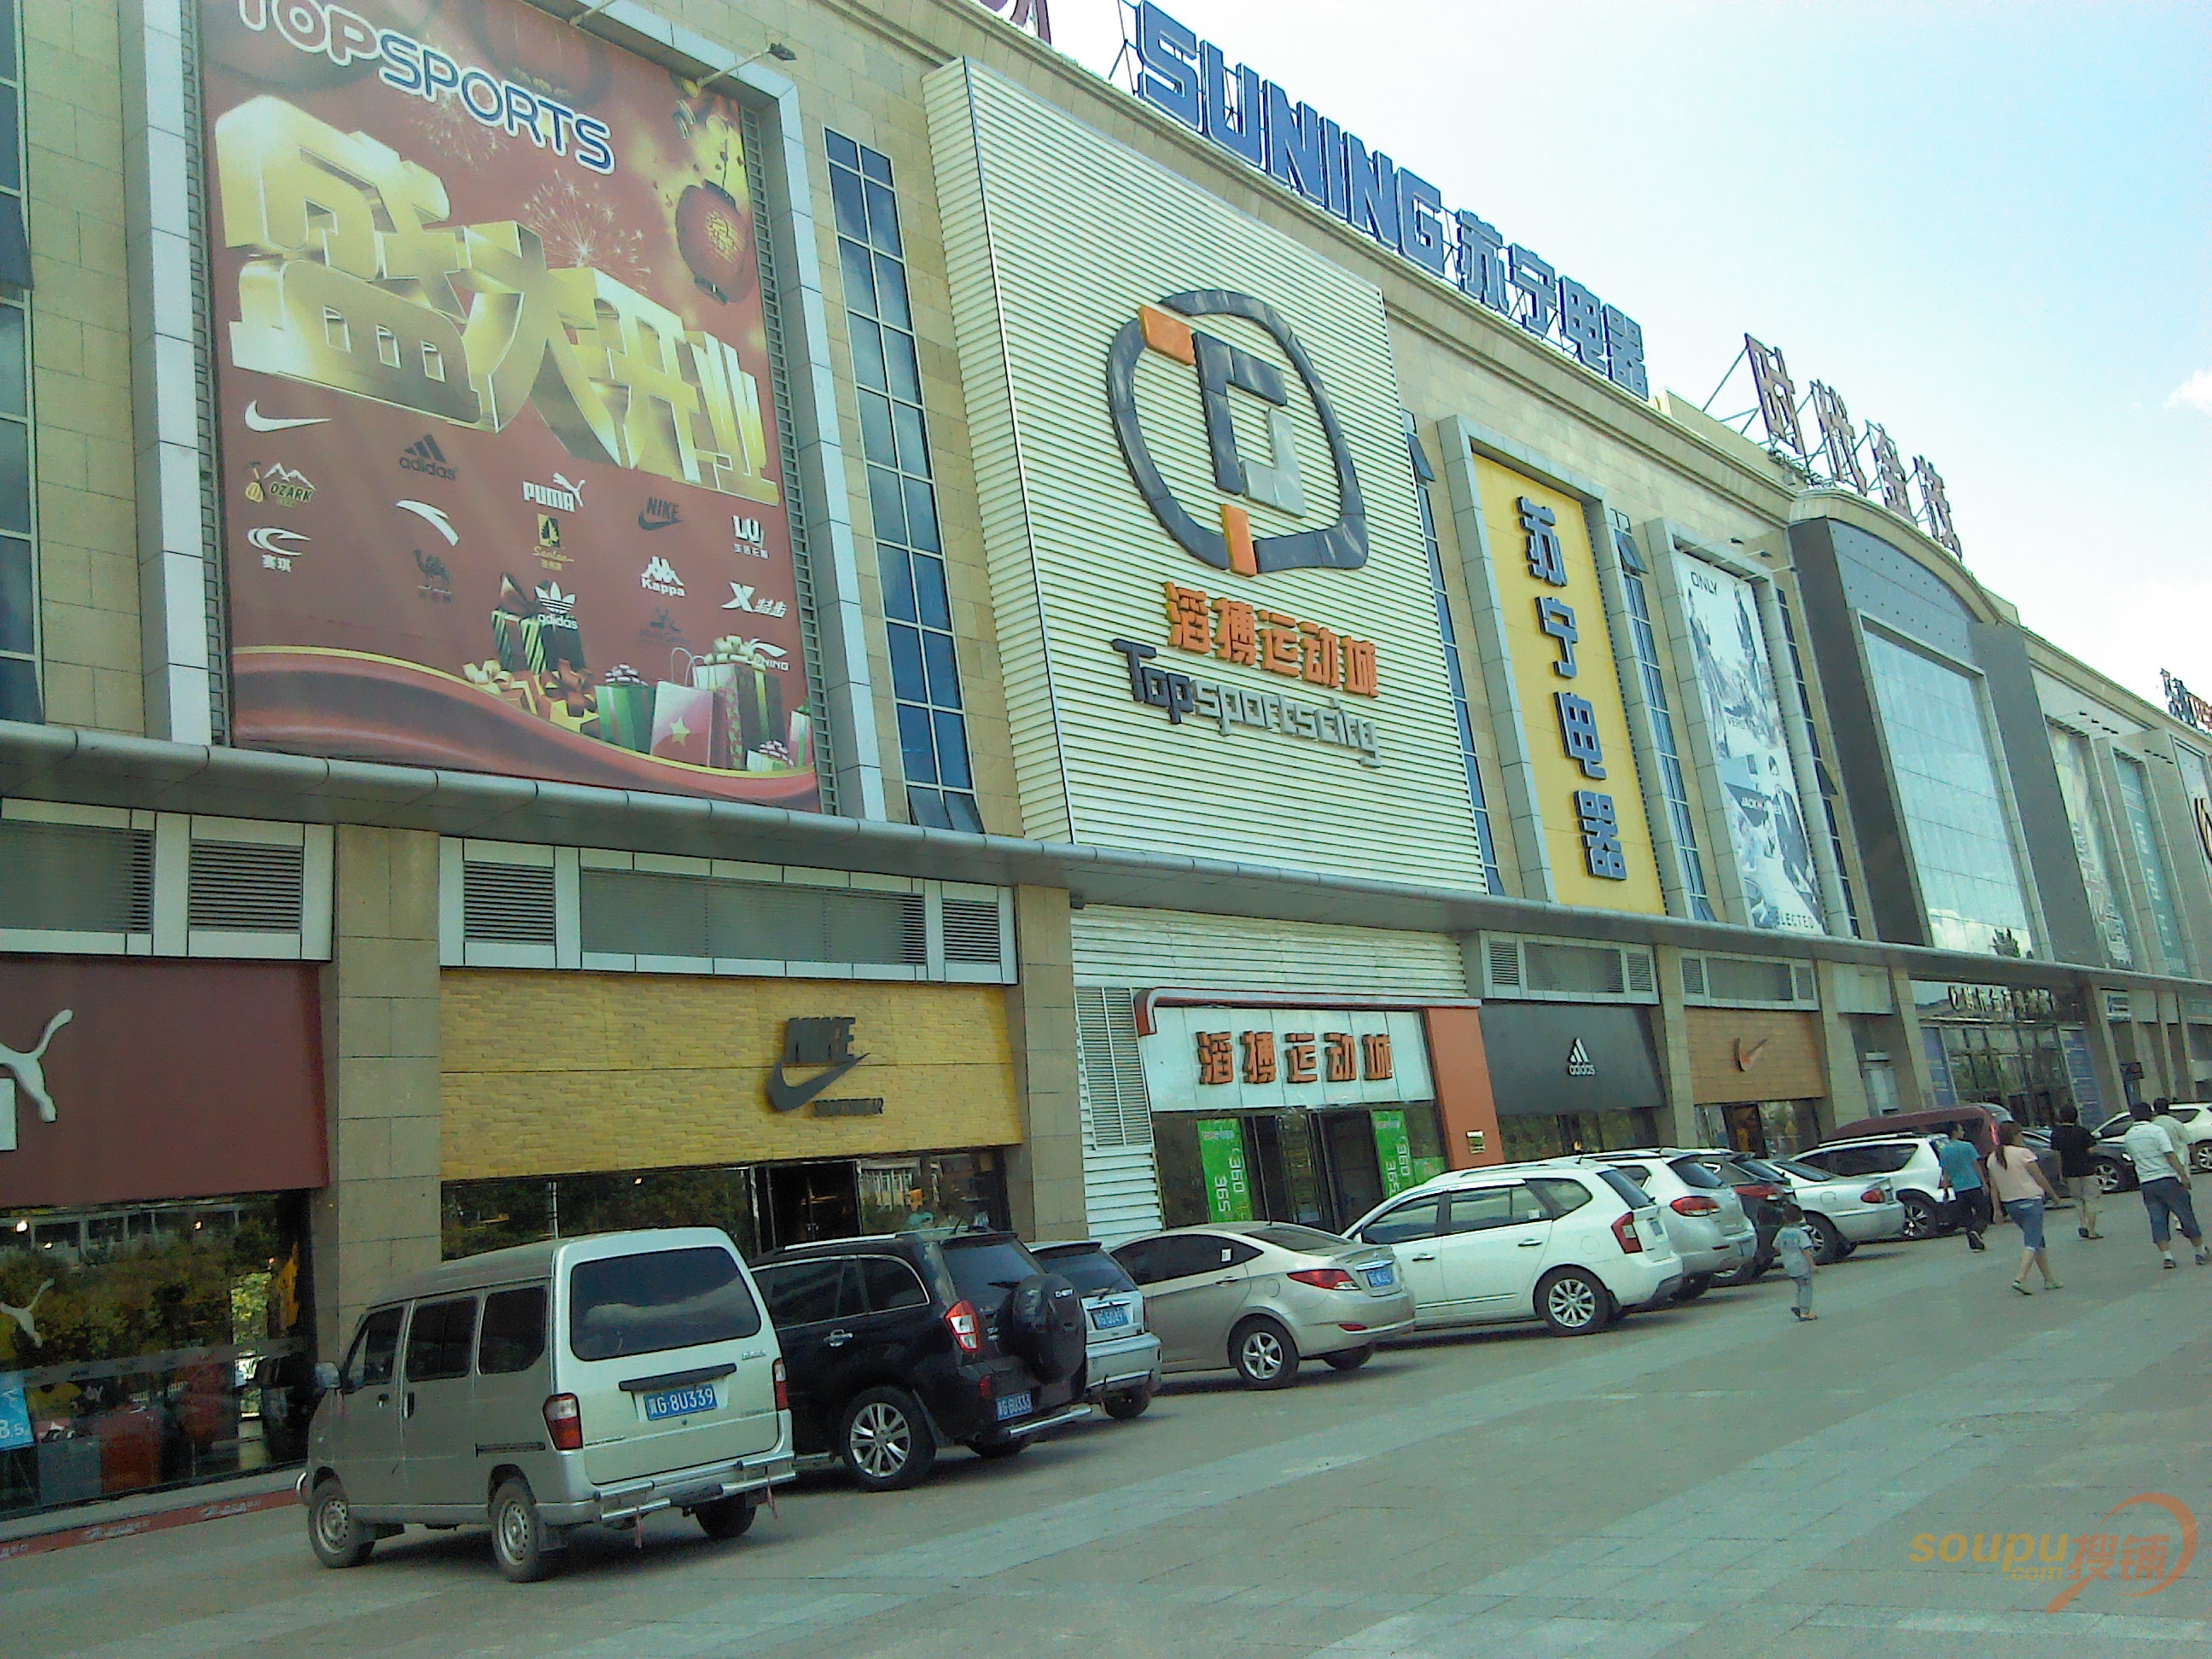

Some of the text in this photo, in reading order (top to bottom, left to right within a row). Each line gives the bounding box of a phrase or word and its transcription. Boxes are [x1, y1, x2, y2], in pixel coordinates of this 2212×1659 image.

[1136, 0, 1444, 277] SUNING
[215, 93, 780, 505] 盛大开业
[1455, 208, 1649, 401] 苏宁电器
[399, 457, 457, 480] adidas
[270, 482, 313, 503] OZARK
[522, 480, 575, 512] PUMA
[646, 497, 680, 521] NIKE
[641, 578, 686, 597] Kappa
[1691, 571, 1718, 596] ONLY
[537, 612, 579, 631] adidas
[754, 597, 788, 618] 特步
[1161, 580, 1379, 698] 滔搏运动城
[1516, 494, 1627, 881] 苏宁电器
[783, 1016, 857, 1064] NIKE
[1195, 1030, 1394, 1085] 滔搏运动城
[1214, 1174, 1231, 1213] 365
